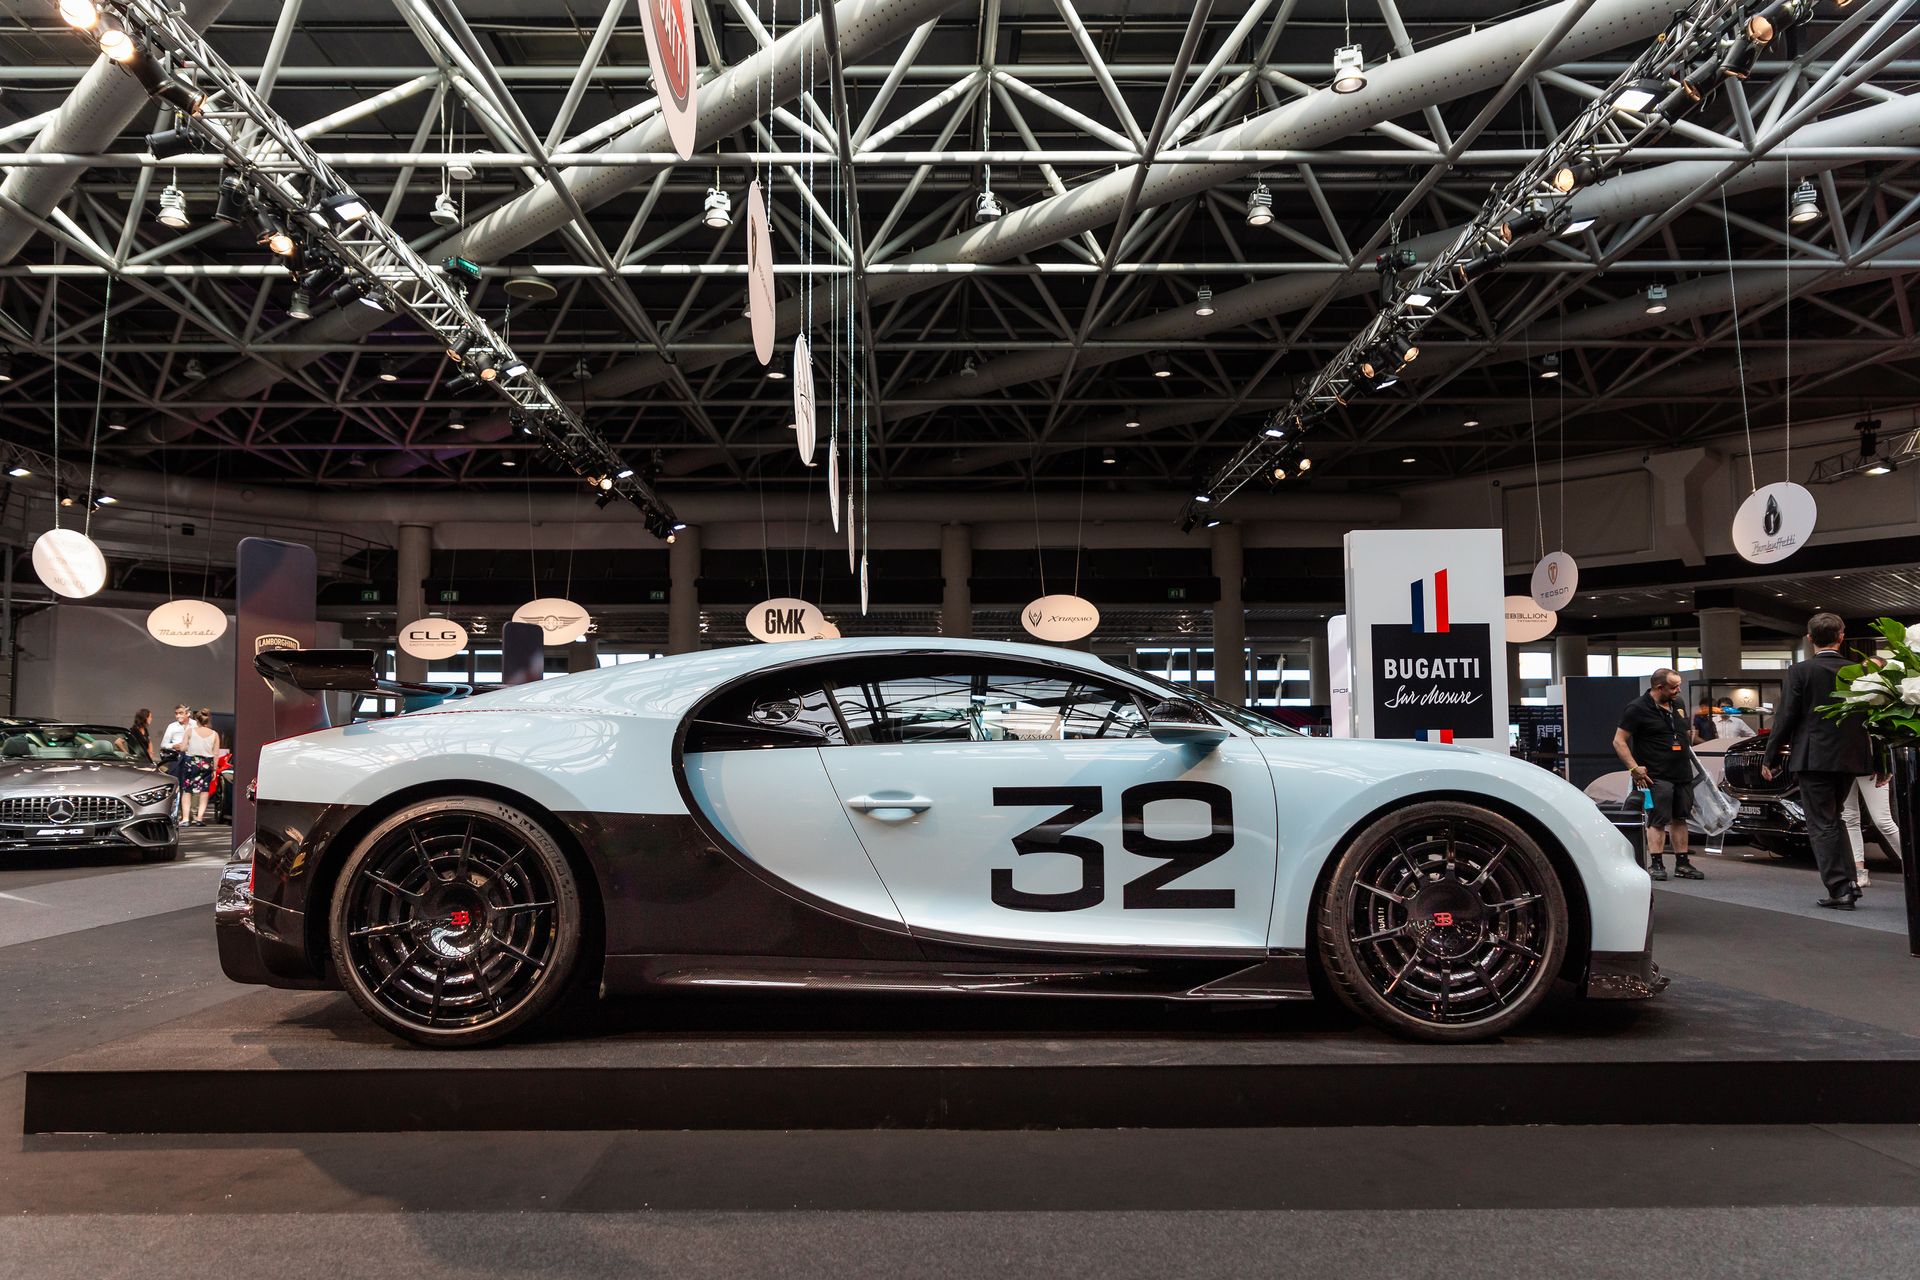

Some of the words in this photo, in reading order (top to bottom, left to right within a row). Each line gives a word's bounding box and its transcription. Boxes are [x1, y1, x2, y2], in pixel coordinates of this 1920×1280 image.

[1540, 586, 1569, 599] TEDSON
[765, 608, 805, 635] GMK
[409, 631, 457, 640] CLG
[1384, 658, 1480, 679] BUGATTI
[1384, 685, 1420, 708] Sur
[1420, 685, 1483, 706] Mesure
[52, 828, 85, 836] AMG
[991, 780, 1235, 912] 32
